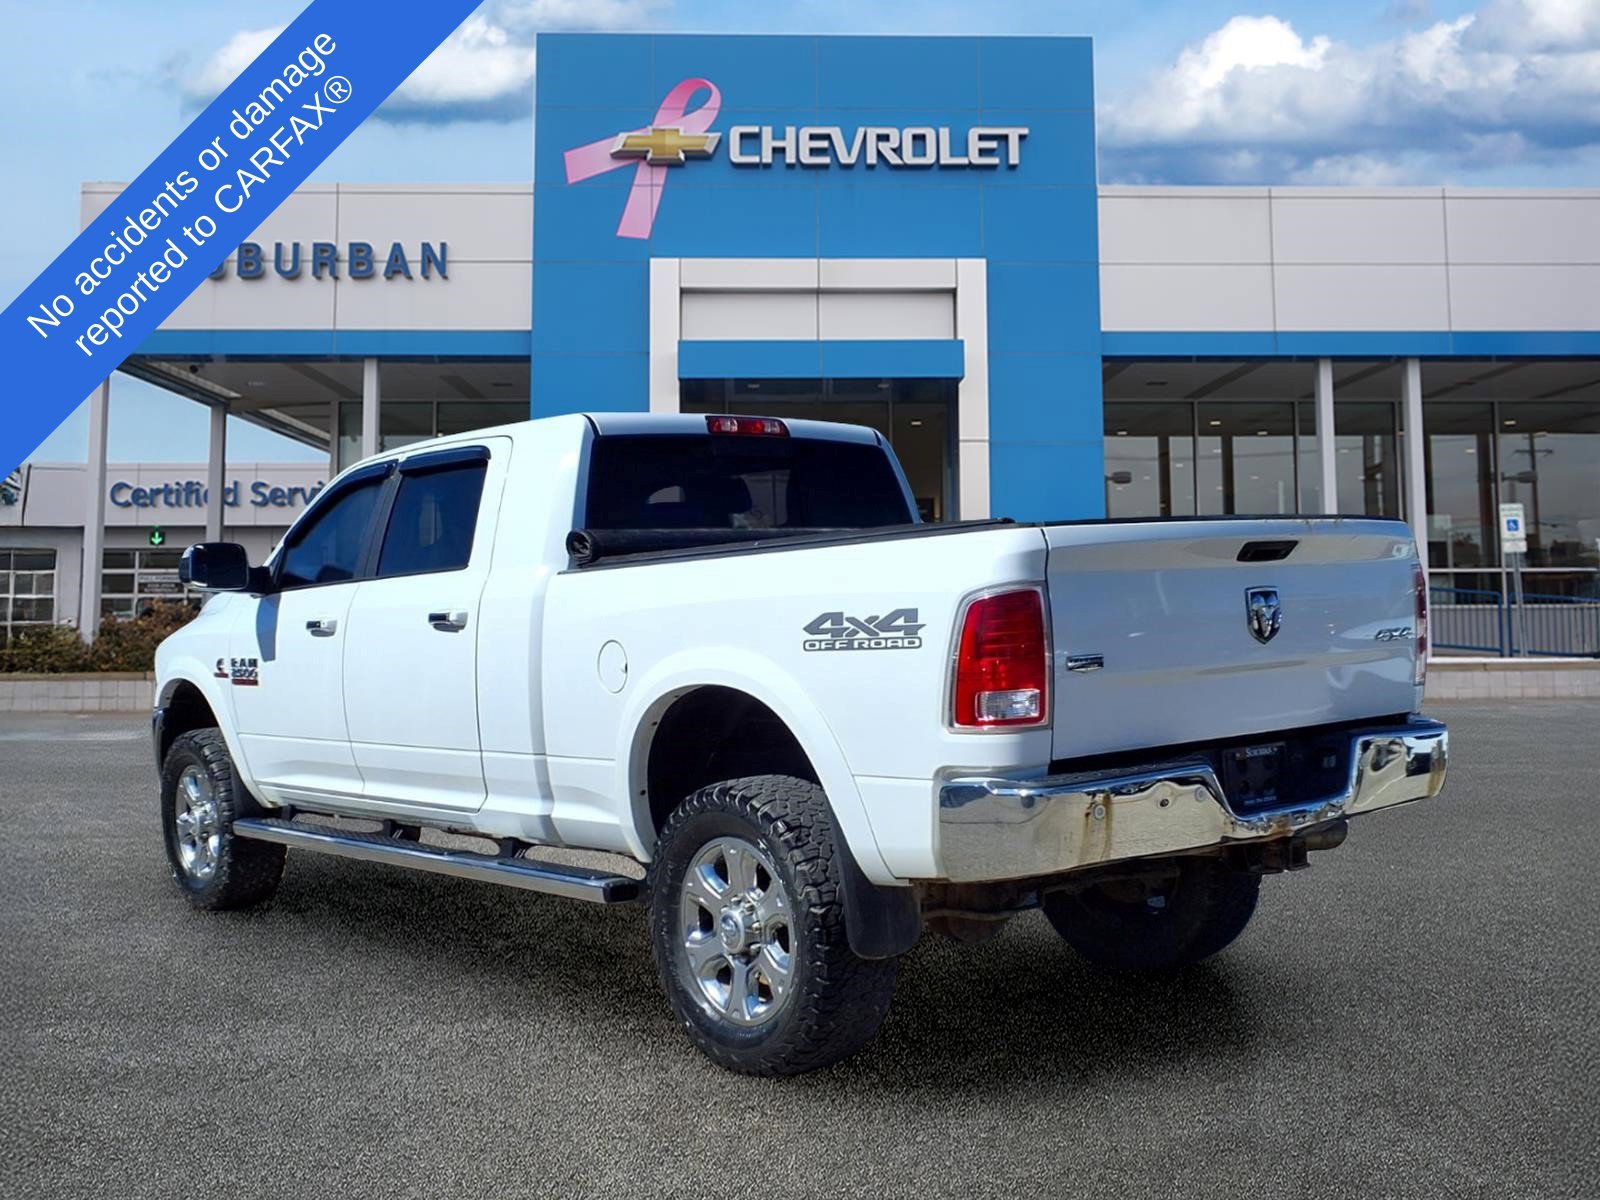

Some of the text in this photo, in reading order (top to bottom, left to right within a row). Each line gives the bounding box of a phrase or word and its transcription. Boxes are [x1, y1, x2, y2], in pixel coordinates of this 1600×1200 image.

[729, 126, 1029, 166] CHEVROLET
[110, 480, 240, 507] Certifid
[803, 608, 926, 638] 4x4
[804, 638, 921, 650] OFF ROAD
